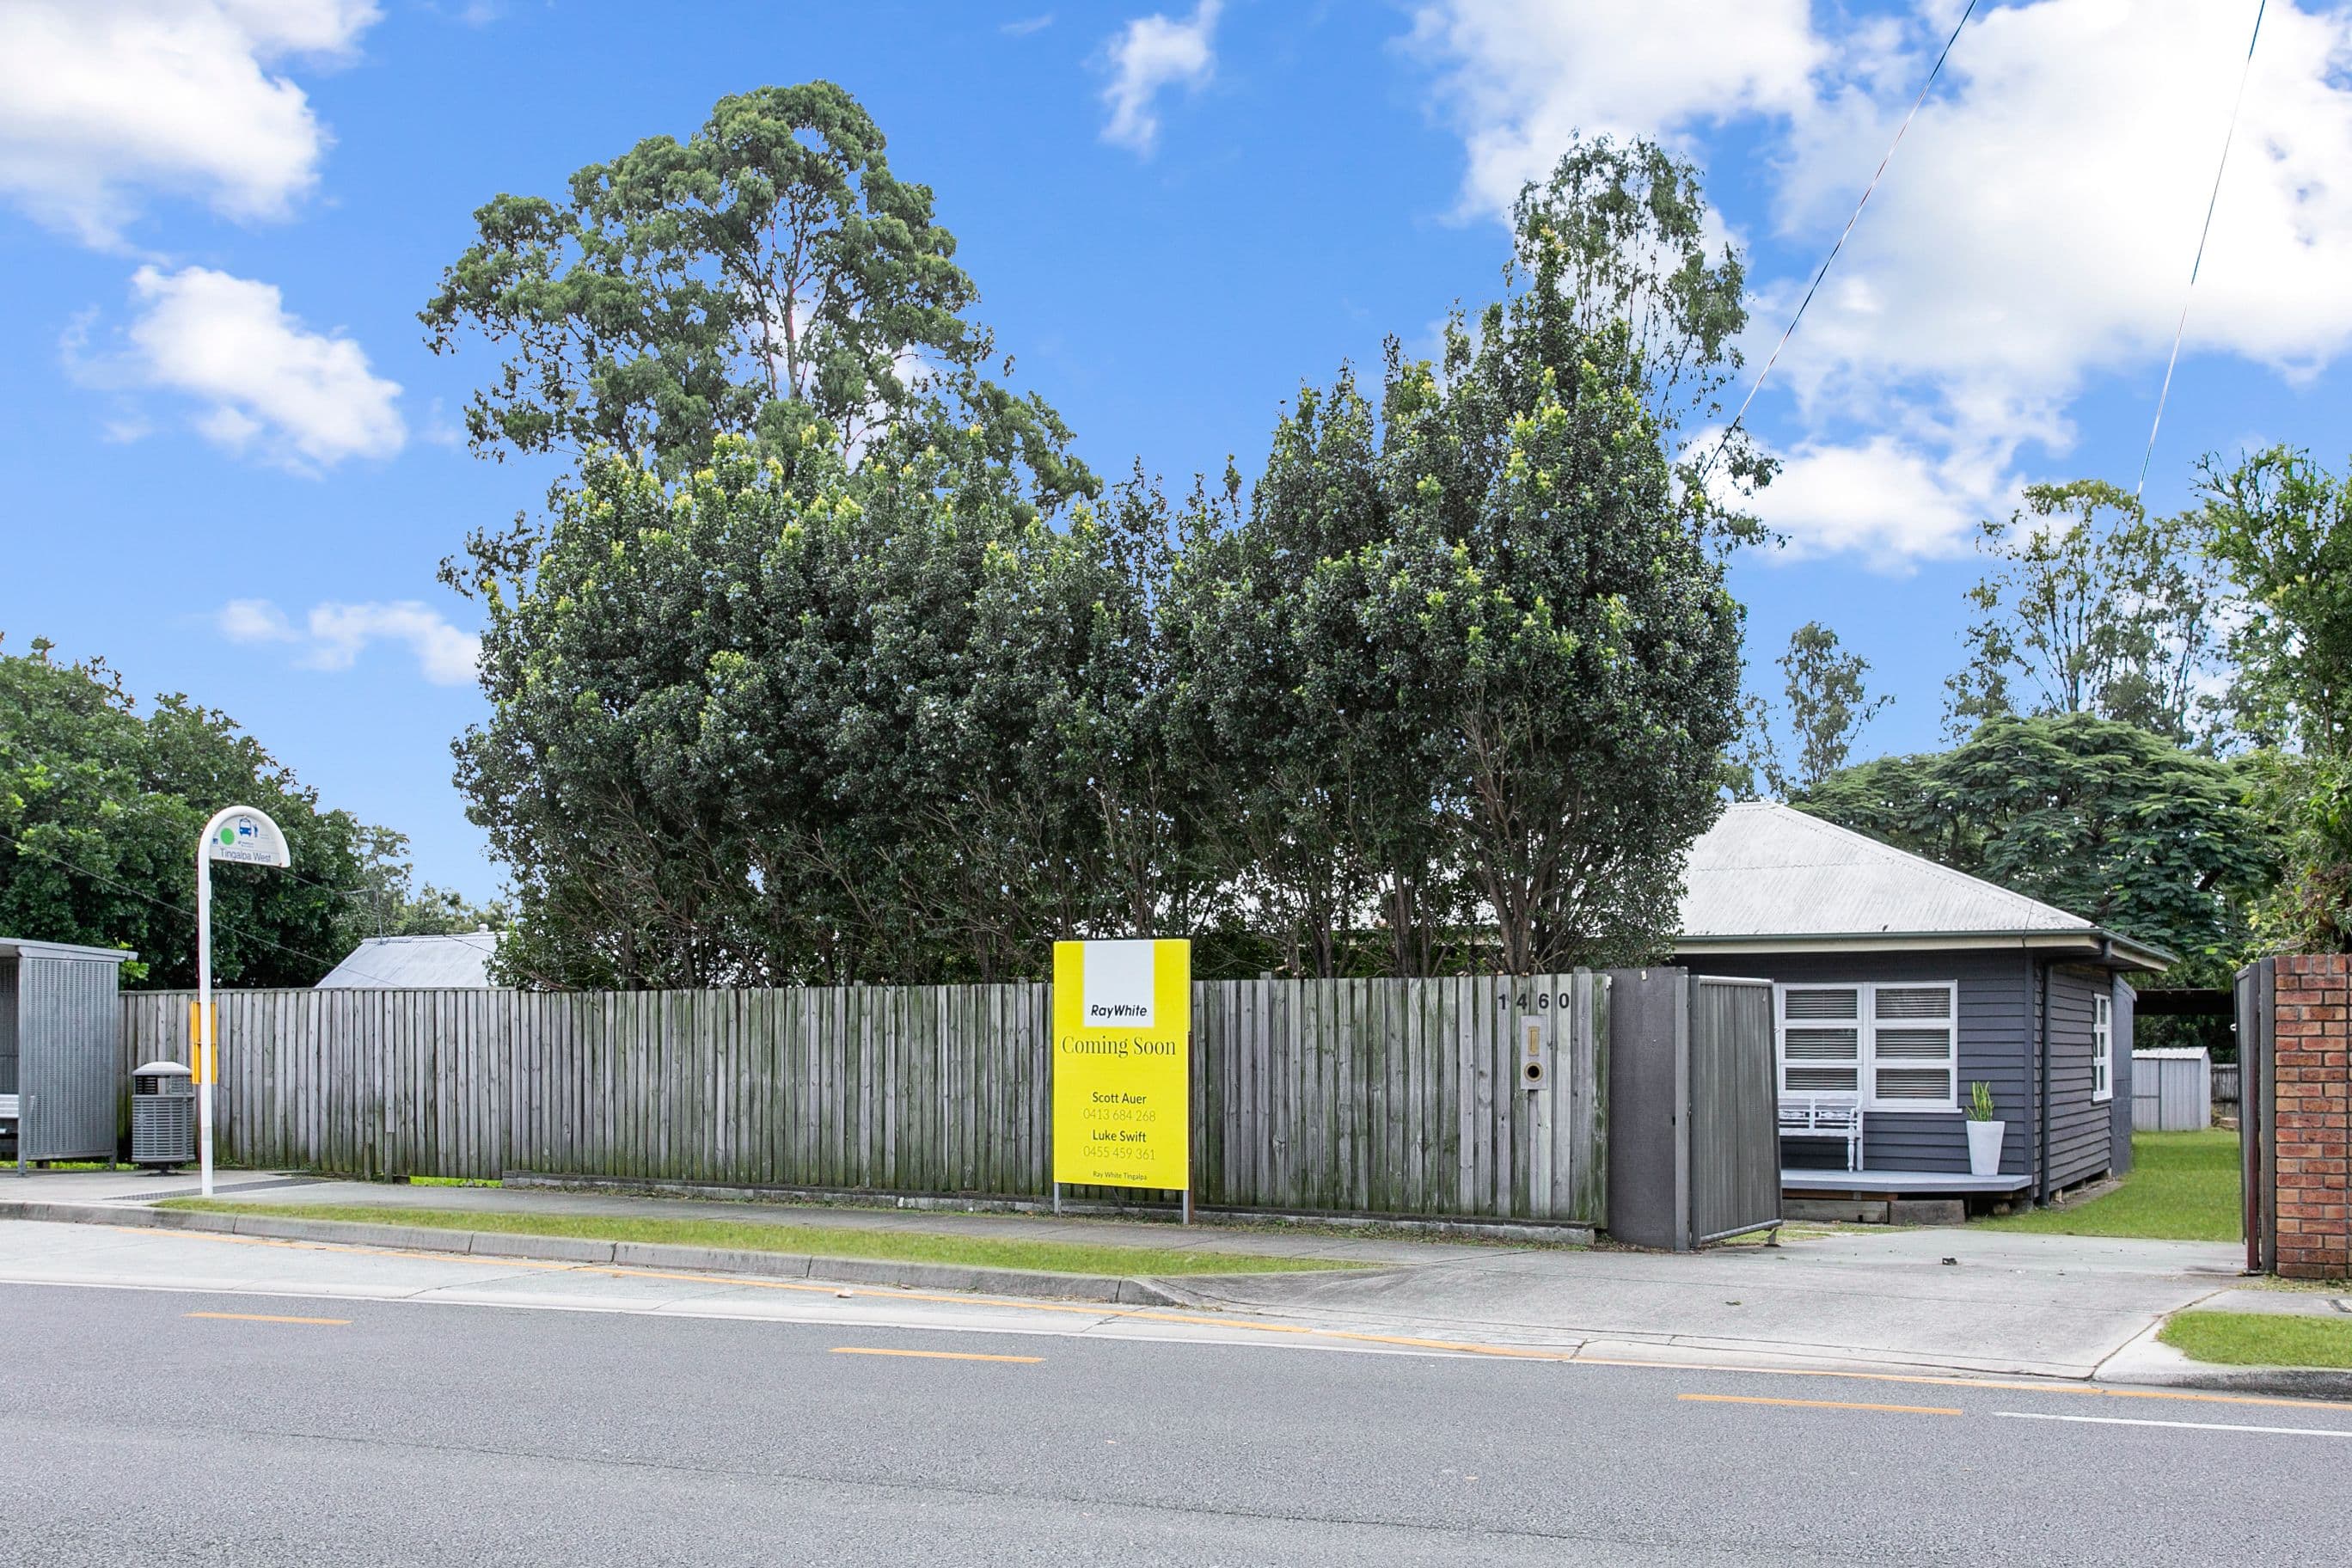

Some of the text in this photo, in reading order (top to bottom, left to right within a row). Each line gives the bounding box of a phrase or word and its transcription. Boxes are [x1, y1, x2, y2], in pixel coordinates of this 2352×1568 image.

[220, 848, 271, 861] Tingalpa West
[1498, 993, 1570, 1010] 1460
[1062, 1035, 1176, 1058] Coming Soon
[1093, 1091, 1147, 1105] Scott Auer
[1083, 1108, 1156, 1122] 0413 684 268
[1093, 1129, 1147, 1142] Luke Swift
[1083, 1145, 1155, 1161] 0455 459 361
[1123, 1172, 1147, 1181] Tingalpa
